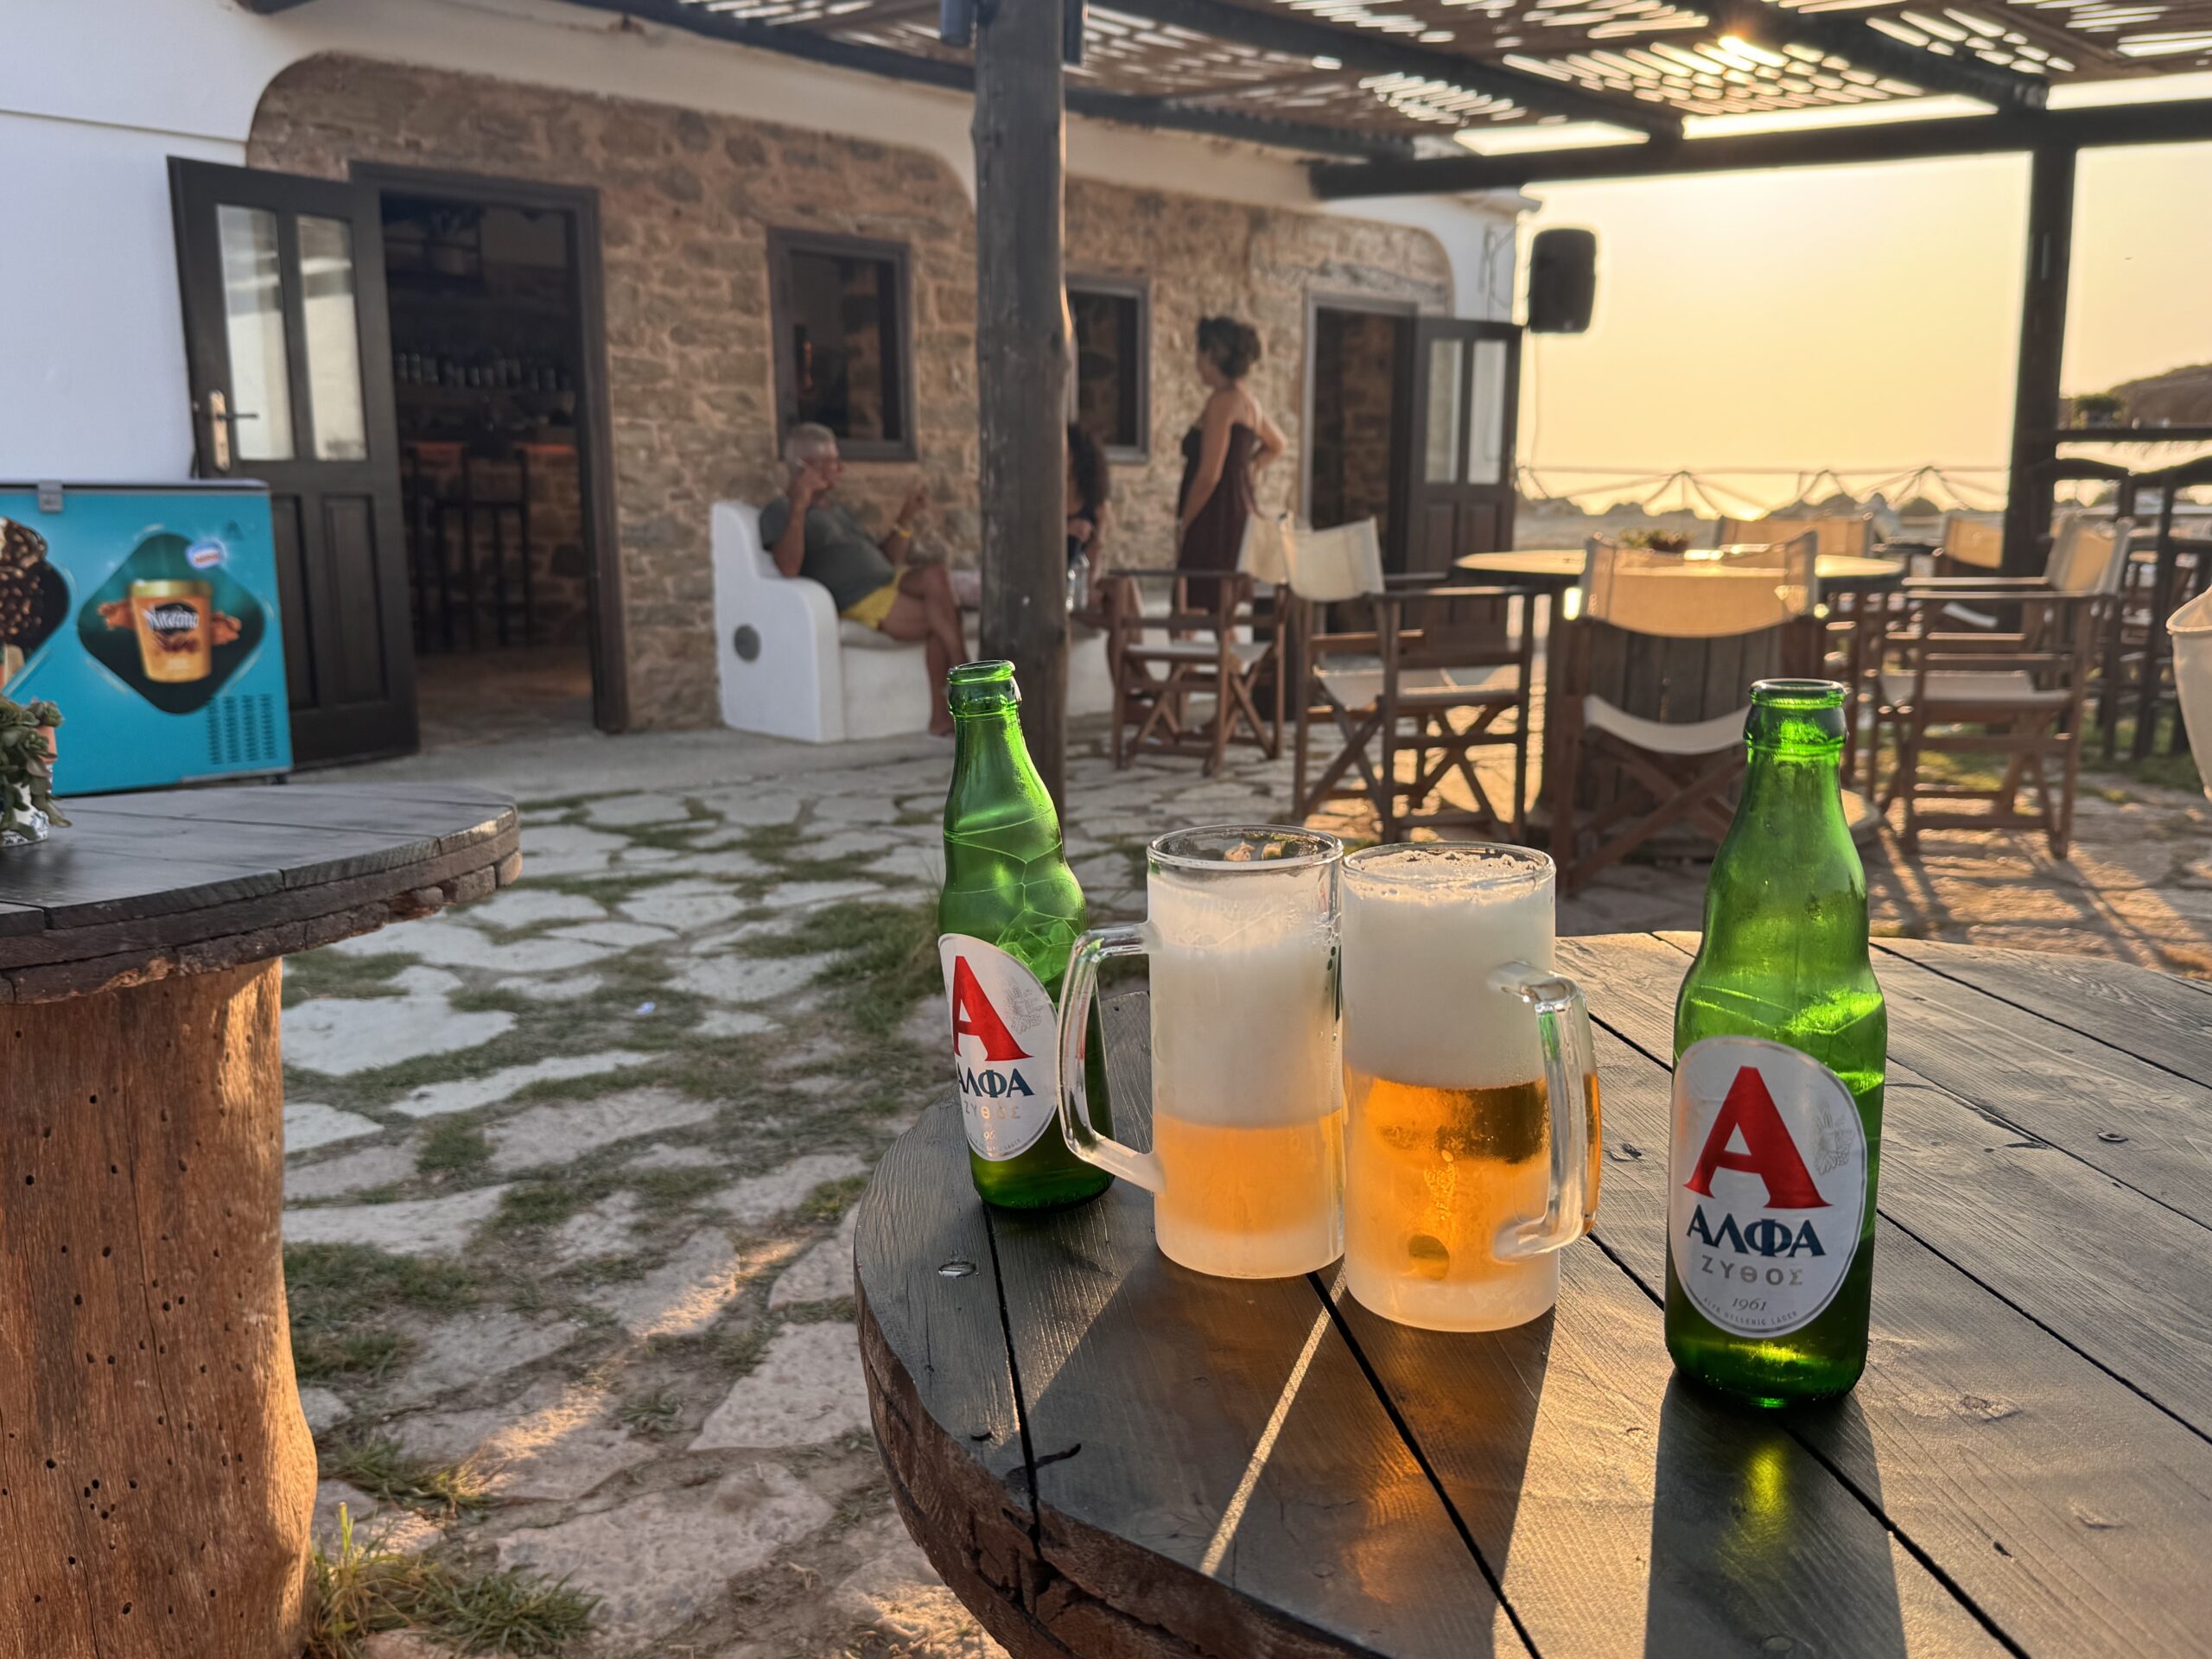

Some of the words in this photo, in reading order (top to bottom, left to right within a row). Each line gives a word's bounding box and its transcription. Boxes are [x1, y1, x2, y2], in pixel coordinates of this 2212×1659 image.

[1687, 1204, 1827, 1257] ΑΛΦΑ
[1701, 1255, 1802, 1286] ΖΥΘΟΣ
[1732, 1297, 1767, 1312] 1961
